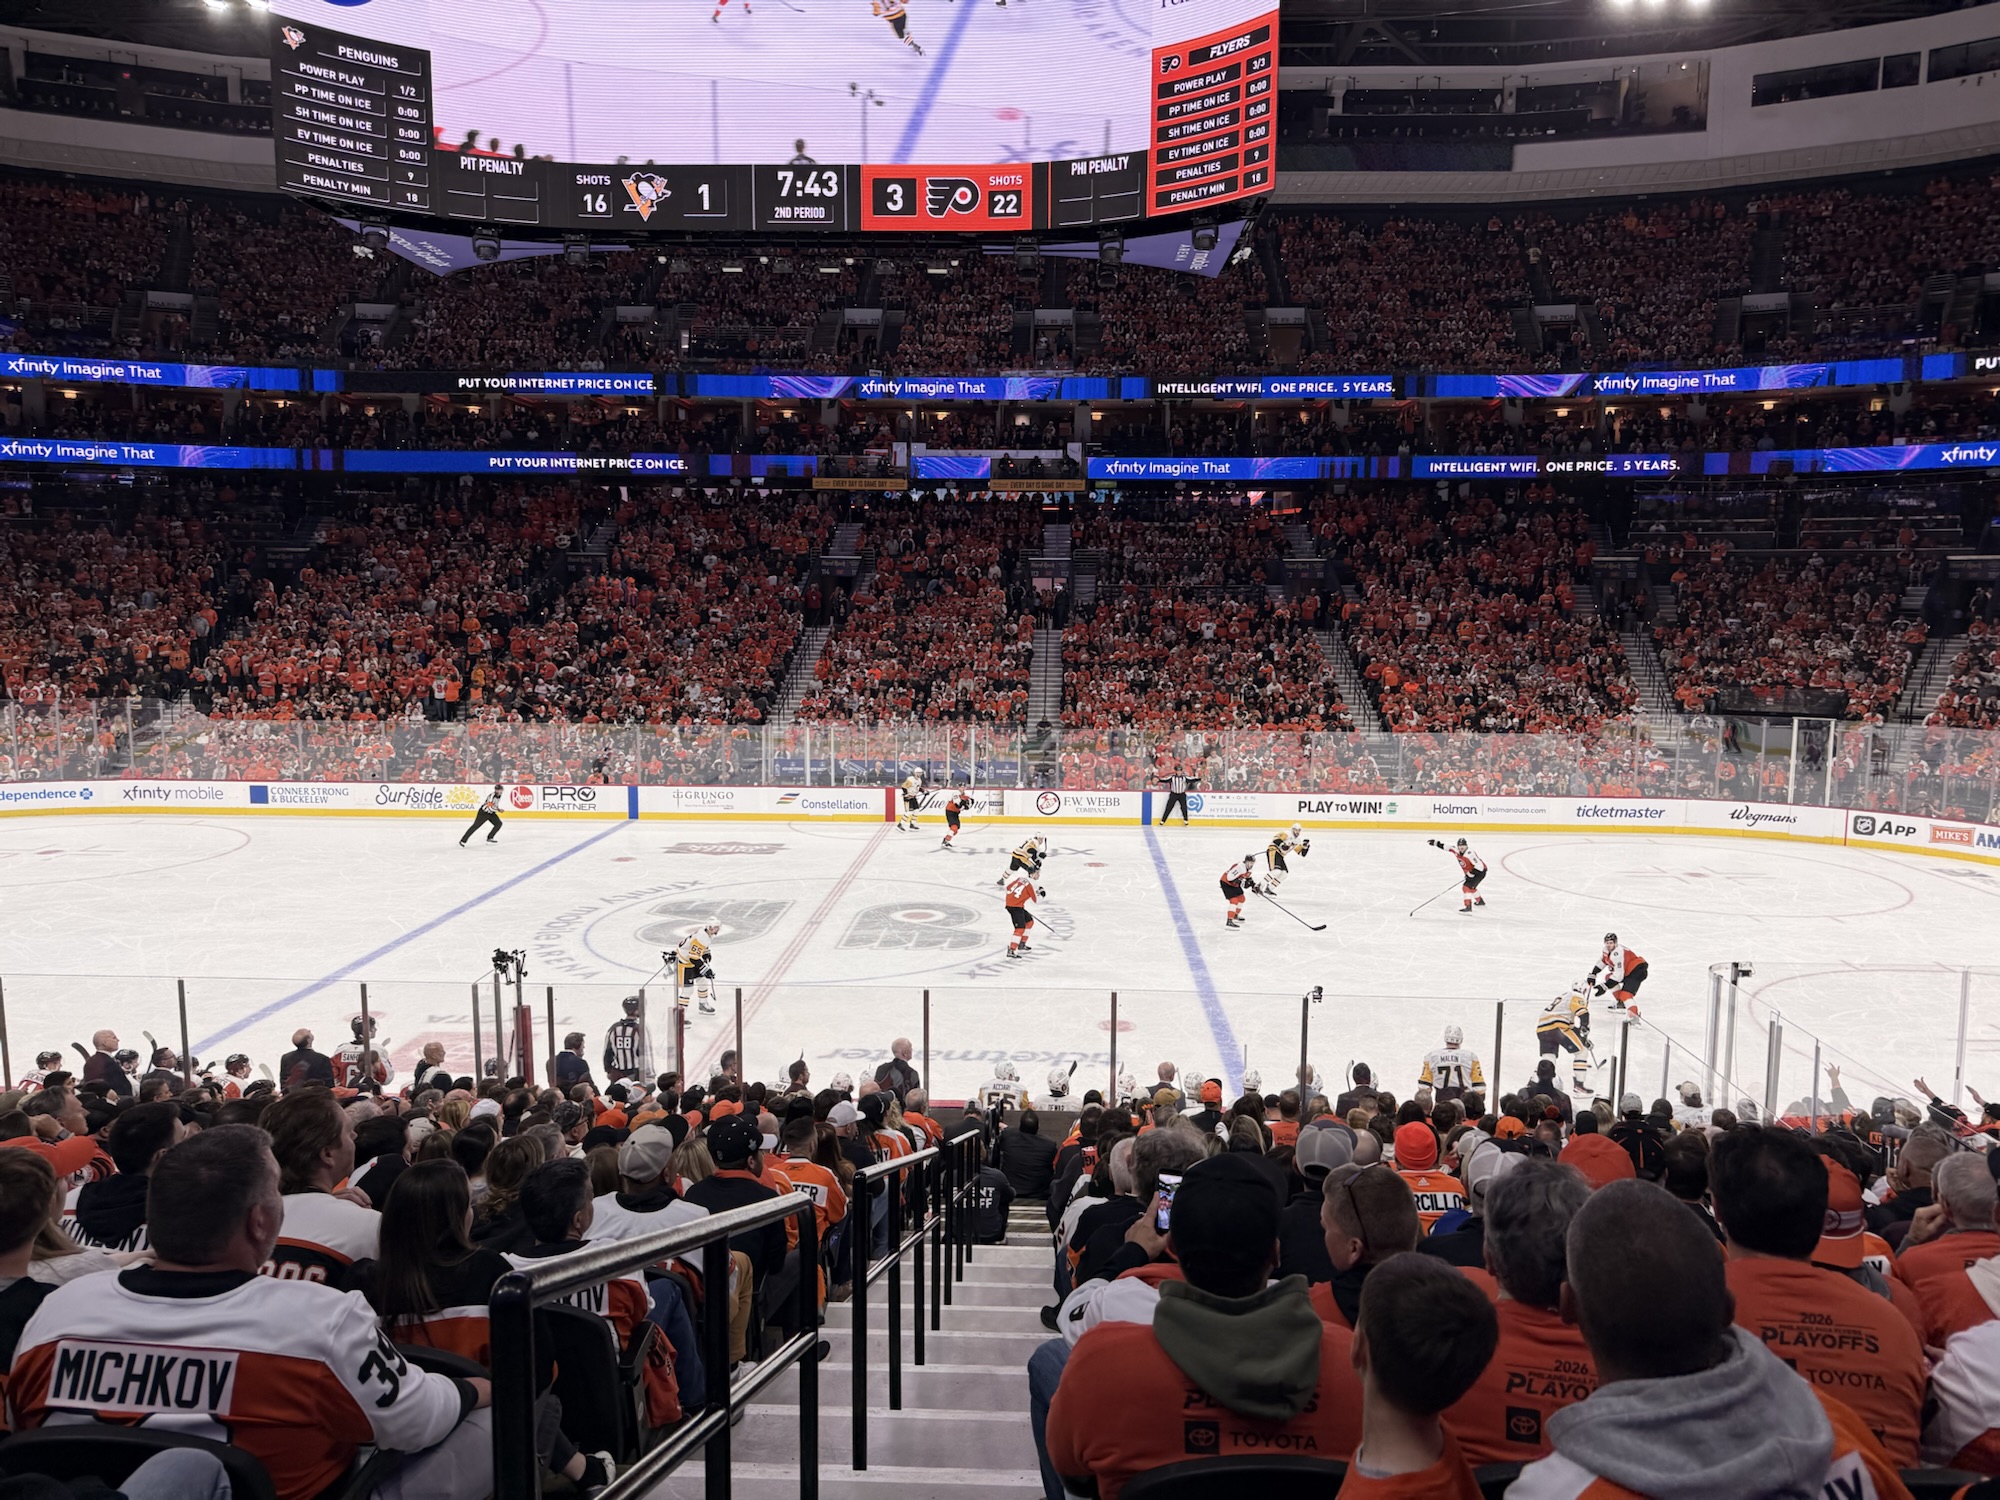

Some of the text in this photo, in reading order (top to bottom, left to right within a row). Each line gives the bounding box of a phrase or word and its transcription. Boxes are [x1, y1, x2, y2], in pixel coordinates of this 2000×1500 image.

[1209, 35, 1251, 58] FLYERS
[338, 45, 399, 68] PENGUINS
[1252, 57, 1266, 70] 3/3
[299, 62, 365, 87] POWER PLAY
[1174, 70, 1227, 93] POWER PLAY
[400, 85, 416, 97] 1/2
[1250, 80, 1267, 94] 0:00
[294, 84, 372, 110] PP TIME ON ICE
[1168, 92, 1230, 116] PP TIME ON ICE
[398, 106, 419, 118] 0:00
[1249, 104, 1266, 116] 0:00
[295, 106, 372, 131] SH TIME ON ICE
[1168, 114, 1230, 138] SH TIME ON ICE
[398, 128, 420, 140] 0:00
[1249, 126, 1266, 139] 0:00
[297, 128, 373, 153] EV TIME ON ICE
[399, 150, 421, 161] 0:00
[1169, 137, 1229, 160] EV TIME ON ICE
[1253, 151, 1260, 160] 9
[308, 153, 364, 173] PENALTIES
[460, 156, 524, 176] PIT PENALTY
[1071, 156, 1129, 176] PHI PENALTY
[408, 172, 414, 181] 9
[1175, 162, 1221, 180] PENALTIES
[1251, 173, 1262, 184] 18
[303, 174, 371, 196] PENALTY MIN
[576, 174, 611, 186] SHOTS
[776, 170, 839, 198] 7:43
[989, 175, 1023, 186] SHOTS
[406, 192, 418, 203] 18
[698, 184, 710, 211] 1
[886, 183, 903, 212] 3
[1170, 182, 1225, 203] PENALTY MIN
[582, 193, 608, 213] 16
[993, 194, 1018, 215] 22
[774, 206, 826, 219] 2ND PERIOD
[8, 359, 162, 380] xfinity Imagine That
[458, 377, 657, 390] PUT YOUR INTERNET PRICE ON ICE.
[861, 380, 986, 397] xfinity Imagine That
[1158, 381, 1396, 393] INTELLIGENT WIFI. ONE PRICE. 5 YEARS.
[1593, 374, 1736, 392] xfinity Imagine That
[1, 442, 155, 462] xfinity Imagine That
[1940, 446, 1997, 462] xfinity
[489, 457, 688, 470] PUT YOUR INTERNET PRICE ON ICE.
[1106, 459, 1230, 477] xfinity Imagine That
[1430, 459, 1680, 473] INTELLIGENT WIFI. ONE PRICE. 5 YEARS.
[122, 785, 224, 801] xfinity mobile
[271, 787, 348, 796] CONNER STRONG
[376, 784, 443, 806] Surfside
[511, 789, 533, 804] Rheem
[542, 786, 596, 801] PRO
[684, 791, 734, 800] GRUNGO
[542, 803, 596, 811] PARTNER
[801, 800, 868, 810] Constellation
[1064, 797, 1120, 807] F.W. WEBB
[1298, 801, 1382, 814] PLAY TO WIN!
[1433, 804, 1477, 815] Holman
[1487, 806, 1546, 814] holmanauto.com
[1576, 805, 1665, 820] ticketmaster
[1728, 805, 1798, 827] Wegmans
[1935, 830, 1969, 842] MIKE'S
[691, 944, 702, 955] 65
[616, 1036, 632, 1049] 68
[1437, 1066, 1465, 1088] 71
[1800, 1312, 1833, 1326] 2026
[1760, 1326, 1879, 1354] PLAYOFFS
[1554, 1360, 1589, 1375] 2026
[52, 1348, 232, 1411] MICHKOV
[1806, 1368, 1886, 1390] TOYOTA
[1229, 1432, 1318, 1450] TOYOTA
